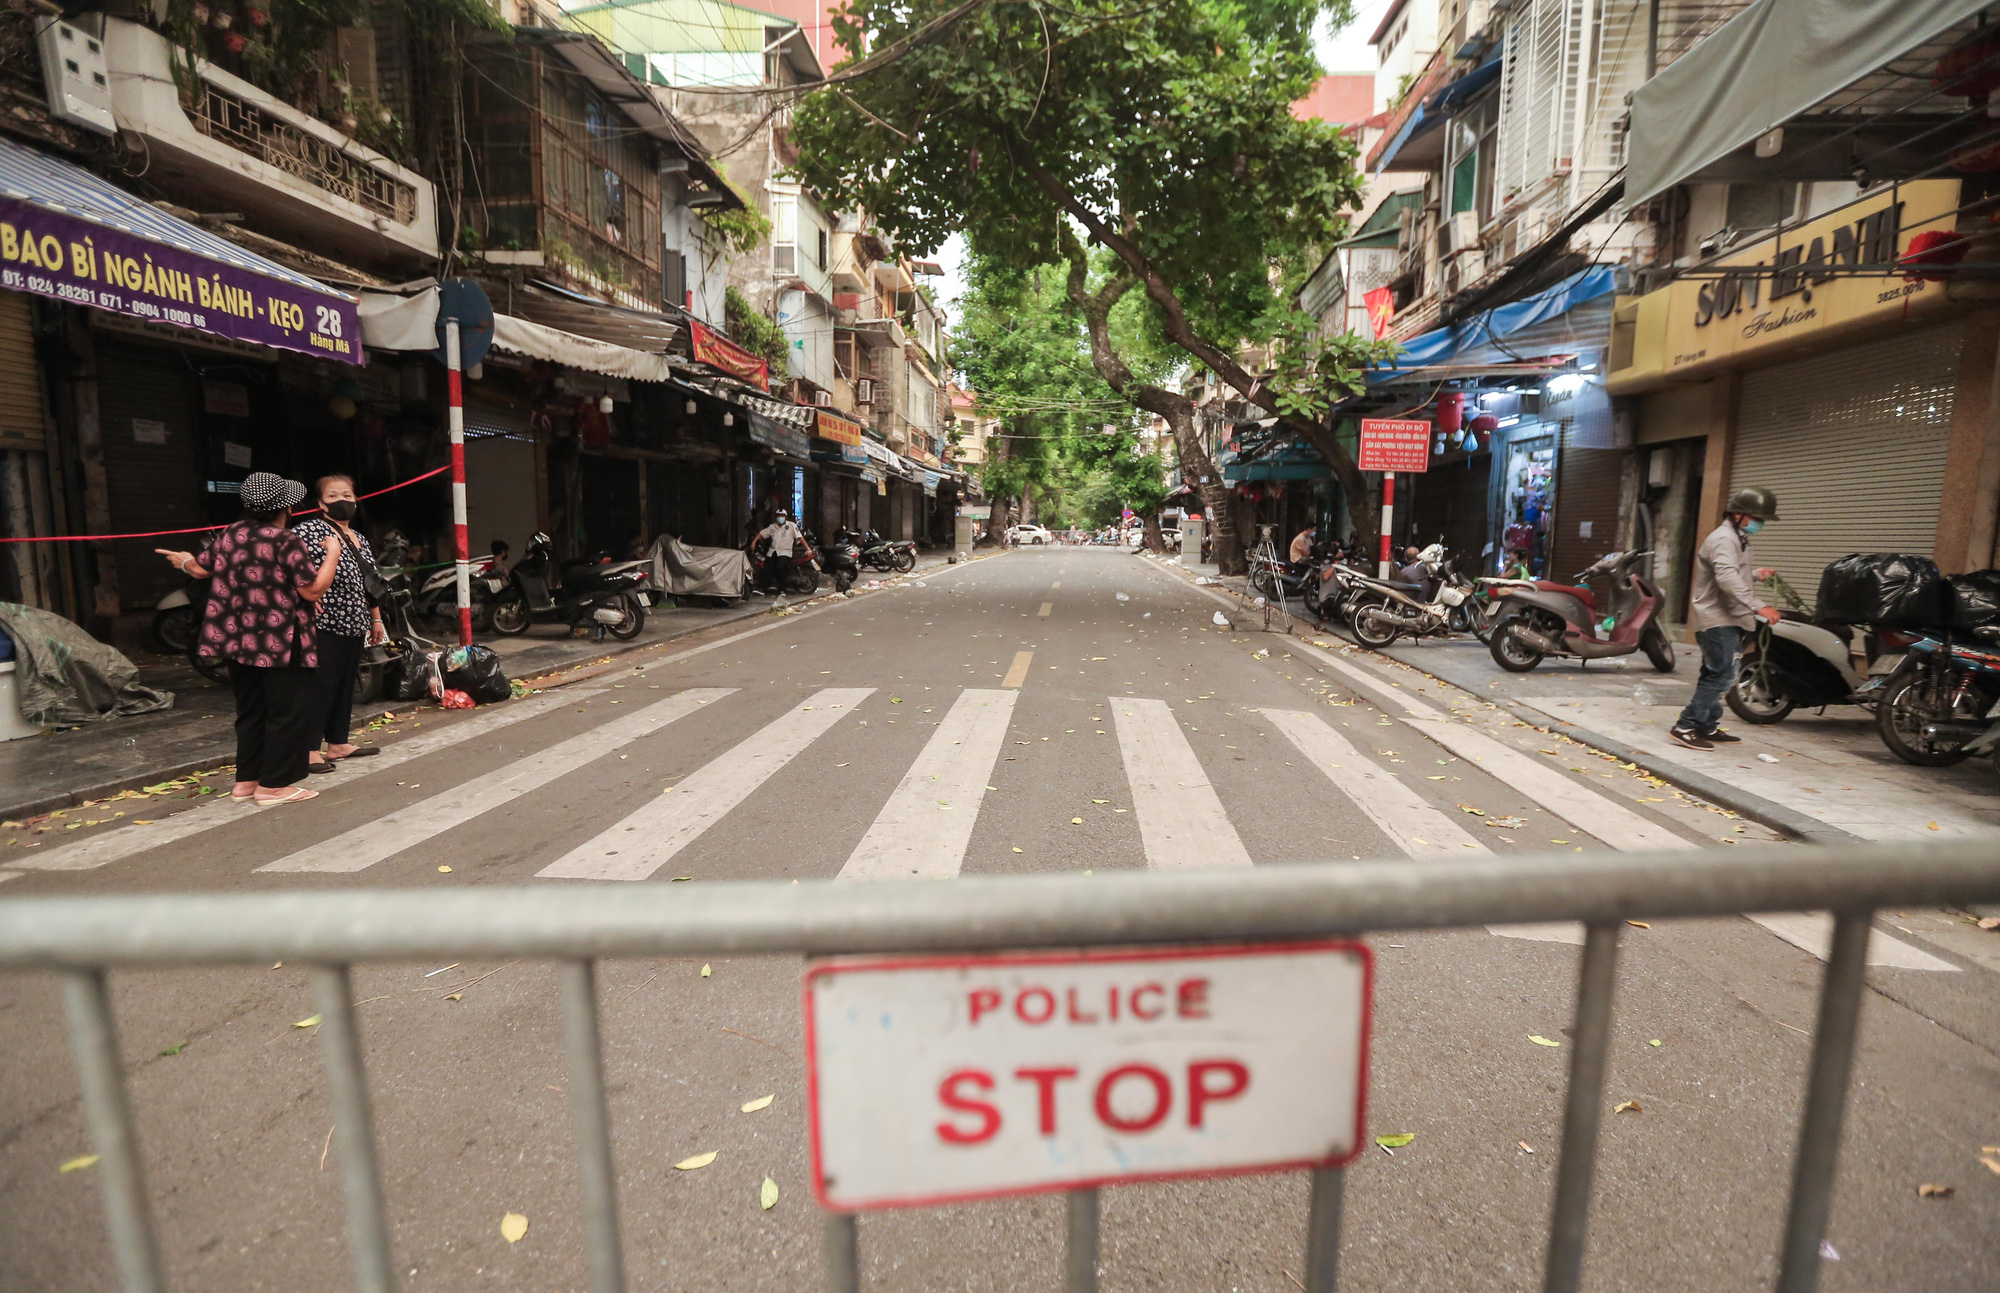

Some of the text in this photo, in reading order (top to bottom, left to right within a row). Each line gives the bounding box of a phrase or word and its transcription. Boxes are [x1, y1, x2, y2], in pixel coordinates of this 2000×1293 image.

[1769, 201, 1905, 304] HẠNH
[0, 222, 305, 337] BAO BÌ NGÀNH BÁNH - KẸO
[2, 269, 25, 288] ĐT:
[28, 277, 55, 295] 024
[57, 282, 96, 304] 38261
[100, 293, 123, 309] 671
[132, 300, 160, 318] 0904
[162, 306, 192, 325] 1000
[193, 313, 207, 328] 66
[310, 331, 351, 354] Hàng Mã
[316, 305, 342, 338] 28
[1742, 306, 1818, 339] Fashion
[1391, 422, 1405, 430] PHỐ
[1414, 423, 1424, 432] BỘ
[967, 977, 1213, 1027] POLICE
[935, 1058, 1250, 1146] STOP
